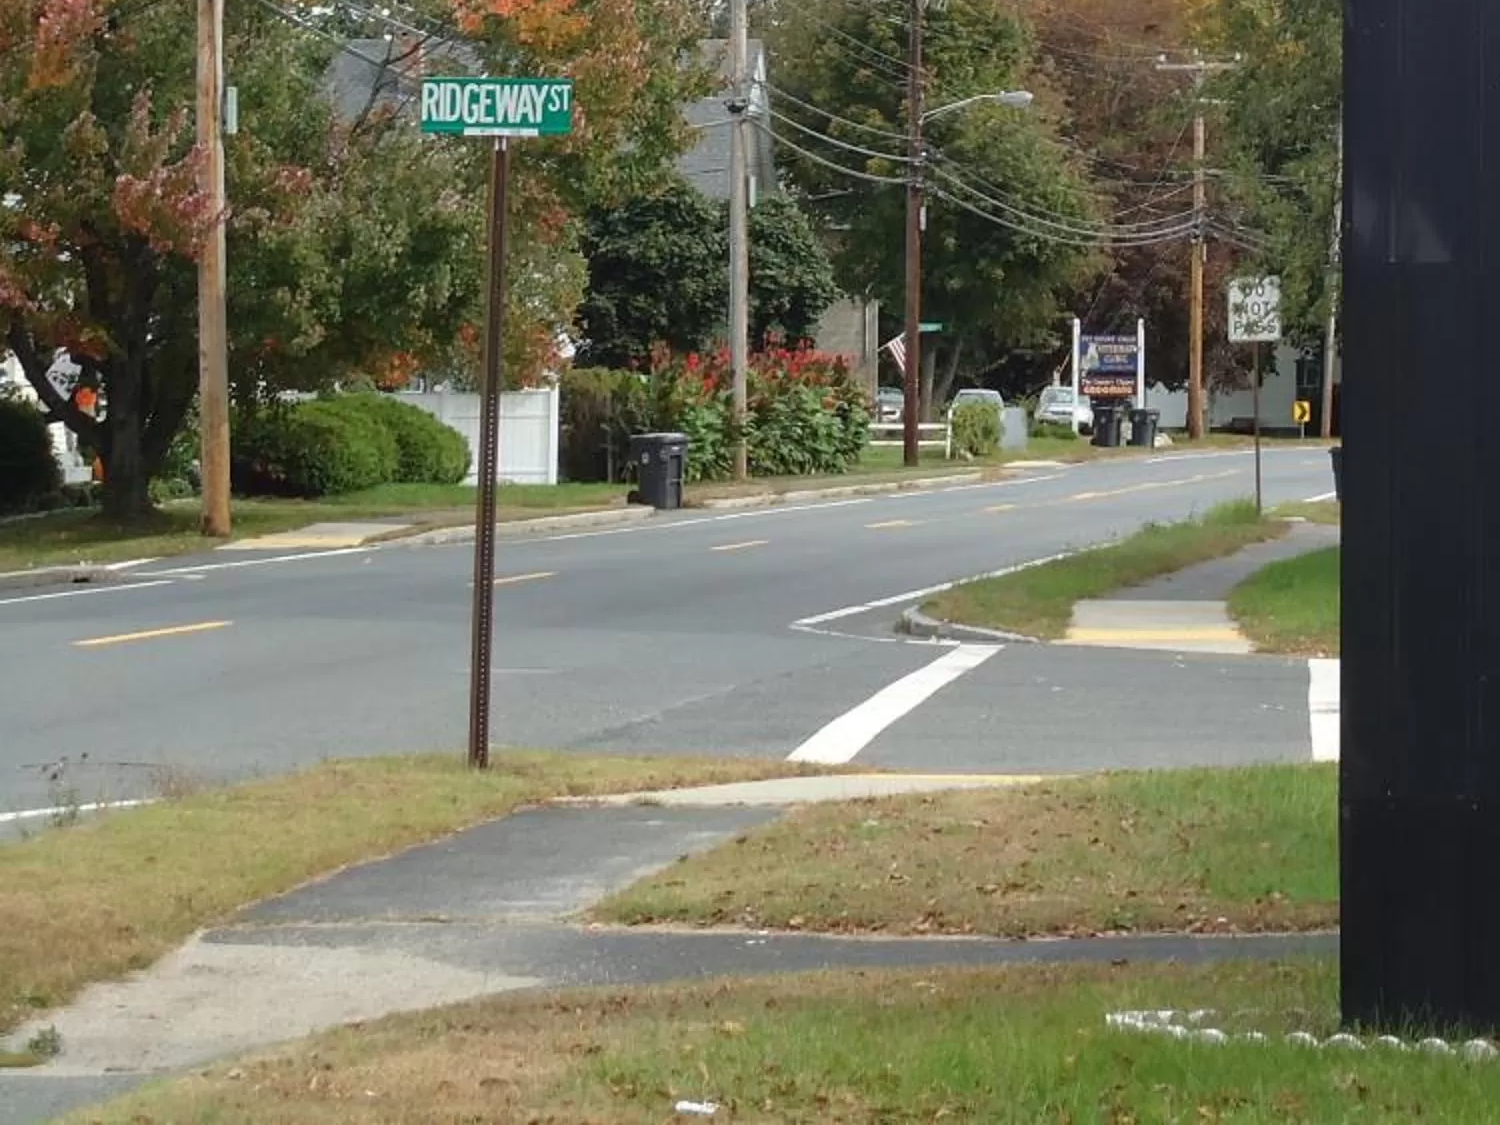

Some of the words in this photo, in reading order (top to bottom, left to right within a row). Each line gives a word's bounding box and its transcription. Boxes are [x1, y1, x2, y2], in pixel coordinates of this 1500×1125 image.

[422, 82, 549, 123] RIDGEWAY
[548, 84, 572, 112] ST
[1234, 320, 1276, 334] PS
